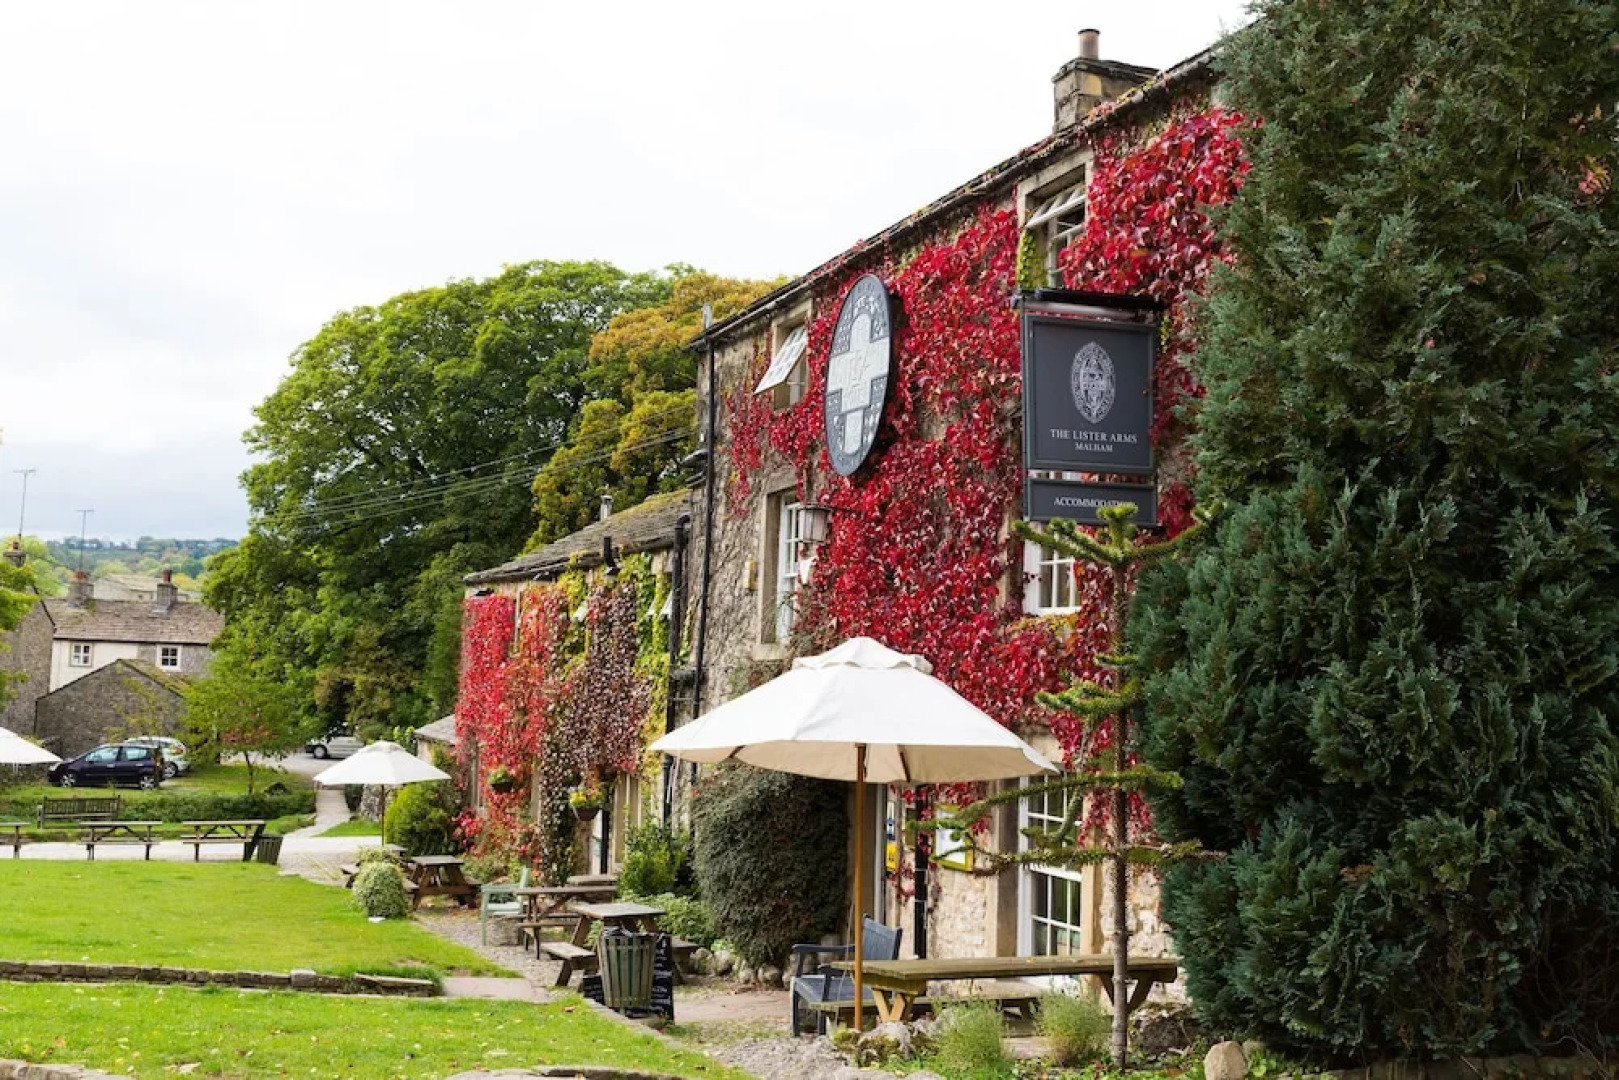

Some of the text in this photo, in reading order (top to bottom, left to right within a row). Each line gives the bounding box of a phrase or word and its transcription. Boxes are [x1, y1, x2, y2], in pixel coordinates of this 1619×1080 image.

[1050, 429, 1137, 444] THE LISTER ARMS
[1074, 442, 1113, 452] MALHAM
[1053, 496, 1135, 508] ACCOMMODAT
